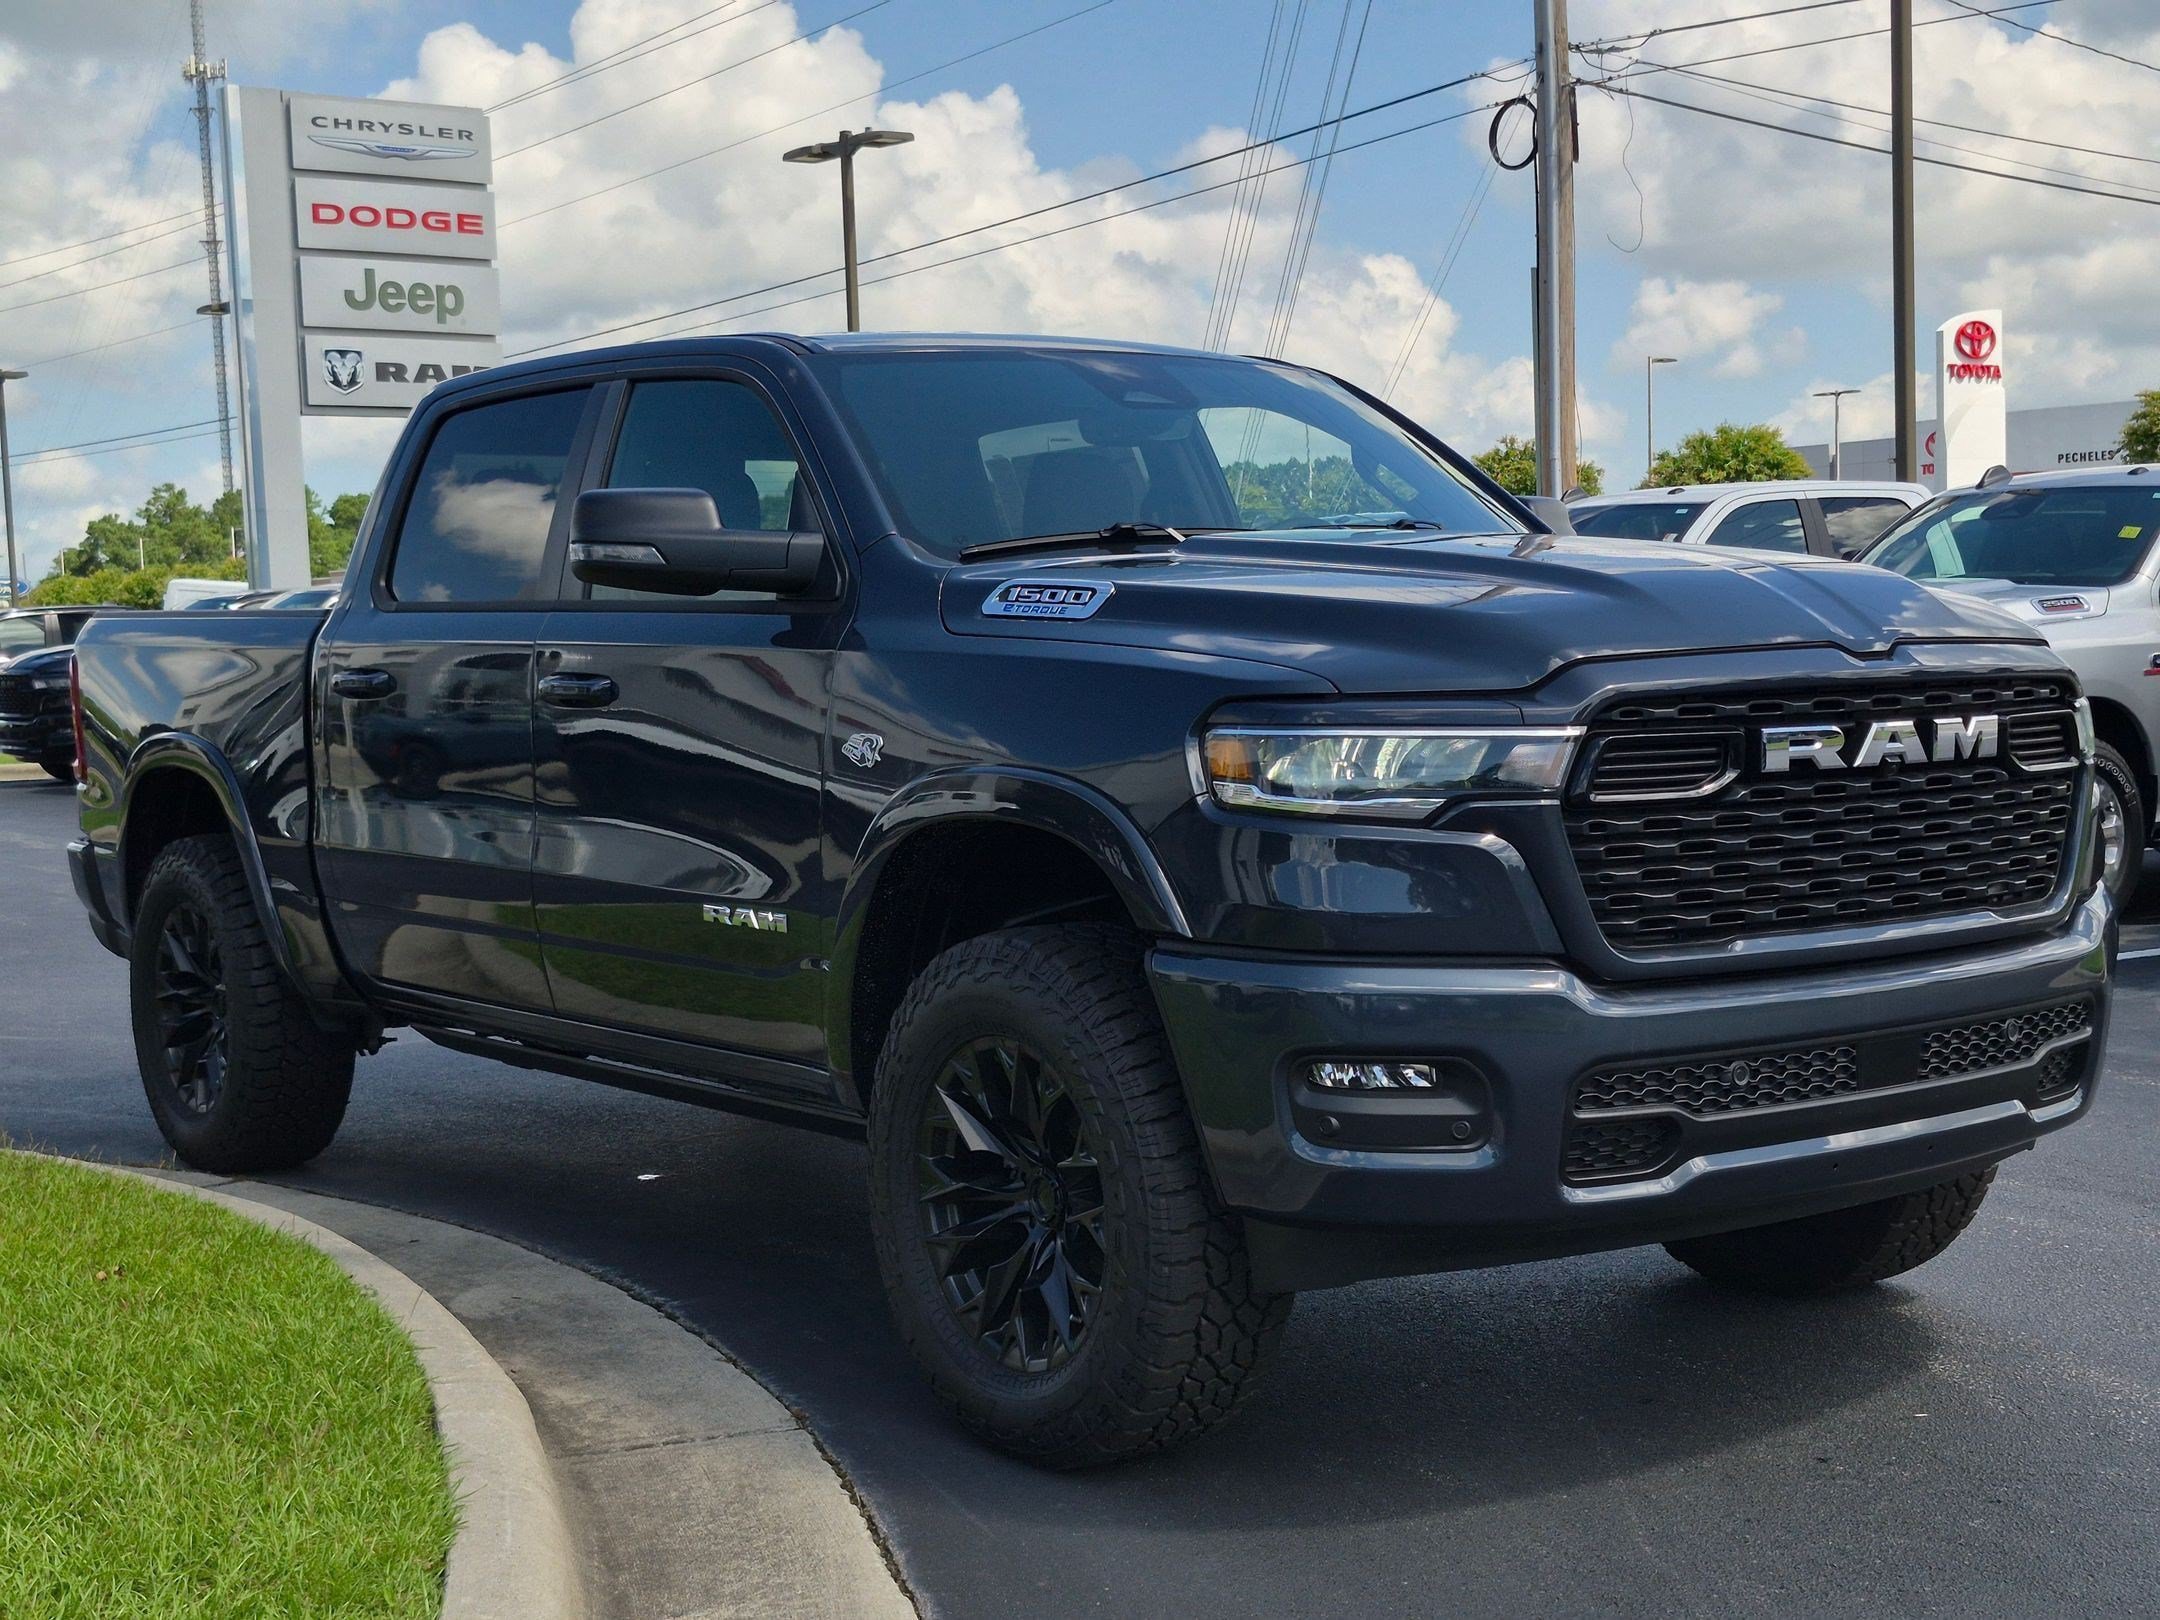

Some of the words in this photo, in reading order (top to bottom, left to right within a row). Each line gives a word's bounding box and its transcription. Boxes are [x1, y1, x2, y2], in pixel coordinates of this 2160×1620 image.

[311, 115, 475, 142] CHRYSLER
[311, 202, 485, 235] DODGE
[343, 267, 465, 324] Jeep
[1947, 363, 2002, 379] TOYOTA
[2057, 450, 2115, 464] PECHELES
[1007, 586, 1093, 604] 1500
[1760, 714, 1999, 773] RAM
[703, 904, 788, 934] RAM
